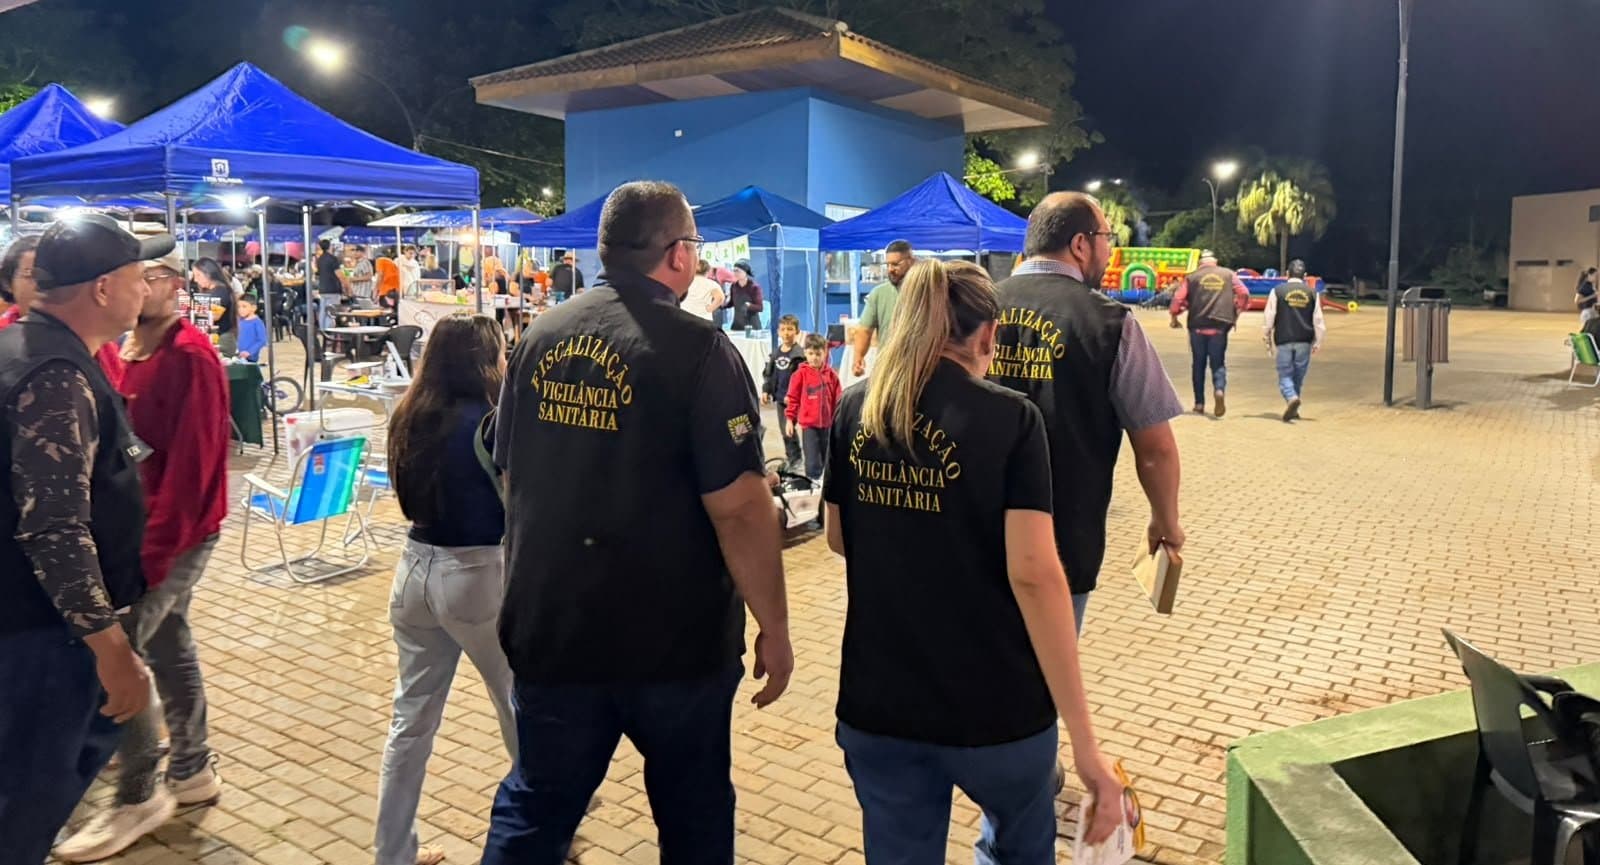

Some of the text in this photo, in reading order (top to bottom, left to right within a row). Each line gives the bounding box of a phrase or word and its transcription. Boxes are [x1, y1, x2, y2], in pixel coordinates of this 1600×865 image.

[998, 308, 1065, 359] ALIZAÇÃO
[994, 342, 1051, 362] GILÂNCIA
[531, 335, 632, 405] FISCALIZAÇÃO
[987, 360, 1053, 379] ANITÁRIA
[543, 380, 618, 409] VIGILÂNCIA
[539, 402, 618, 430] SANITÁRIA
[849, 413, 961, 479] FISCZAÇÃO
[858, 459, 945, 488] VIGILÂNCIA
[858, 483, 941, 512] SANITÁRIA
